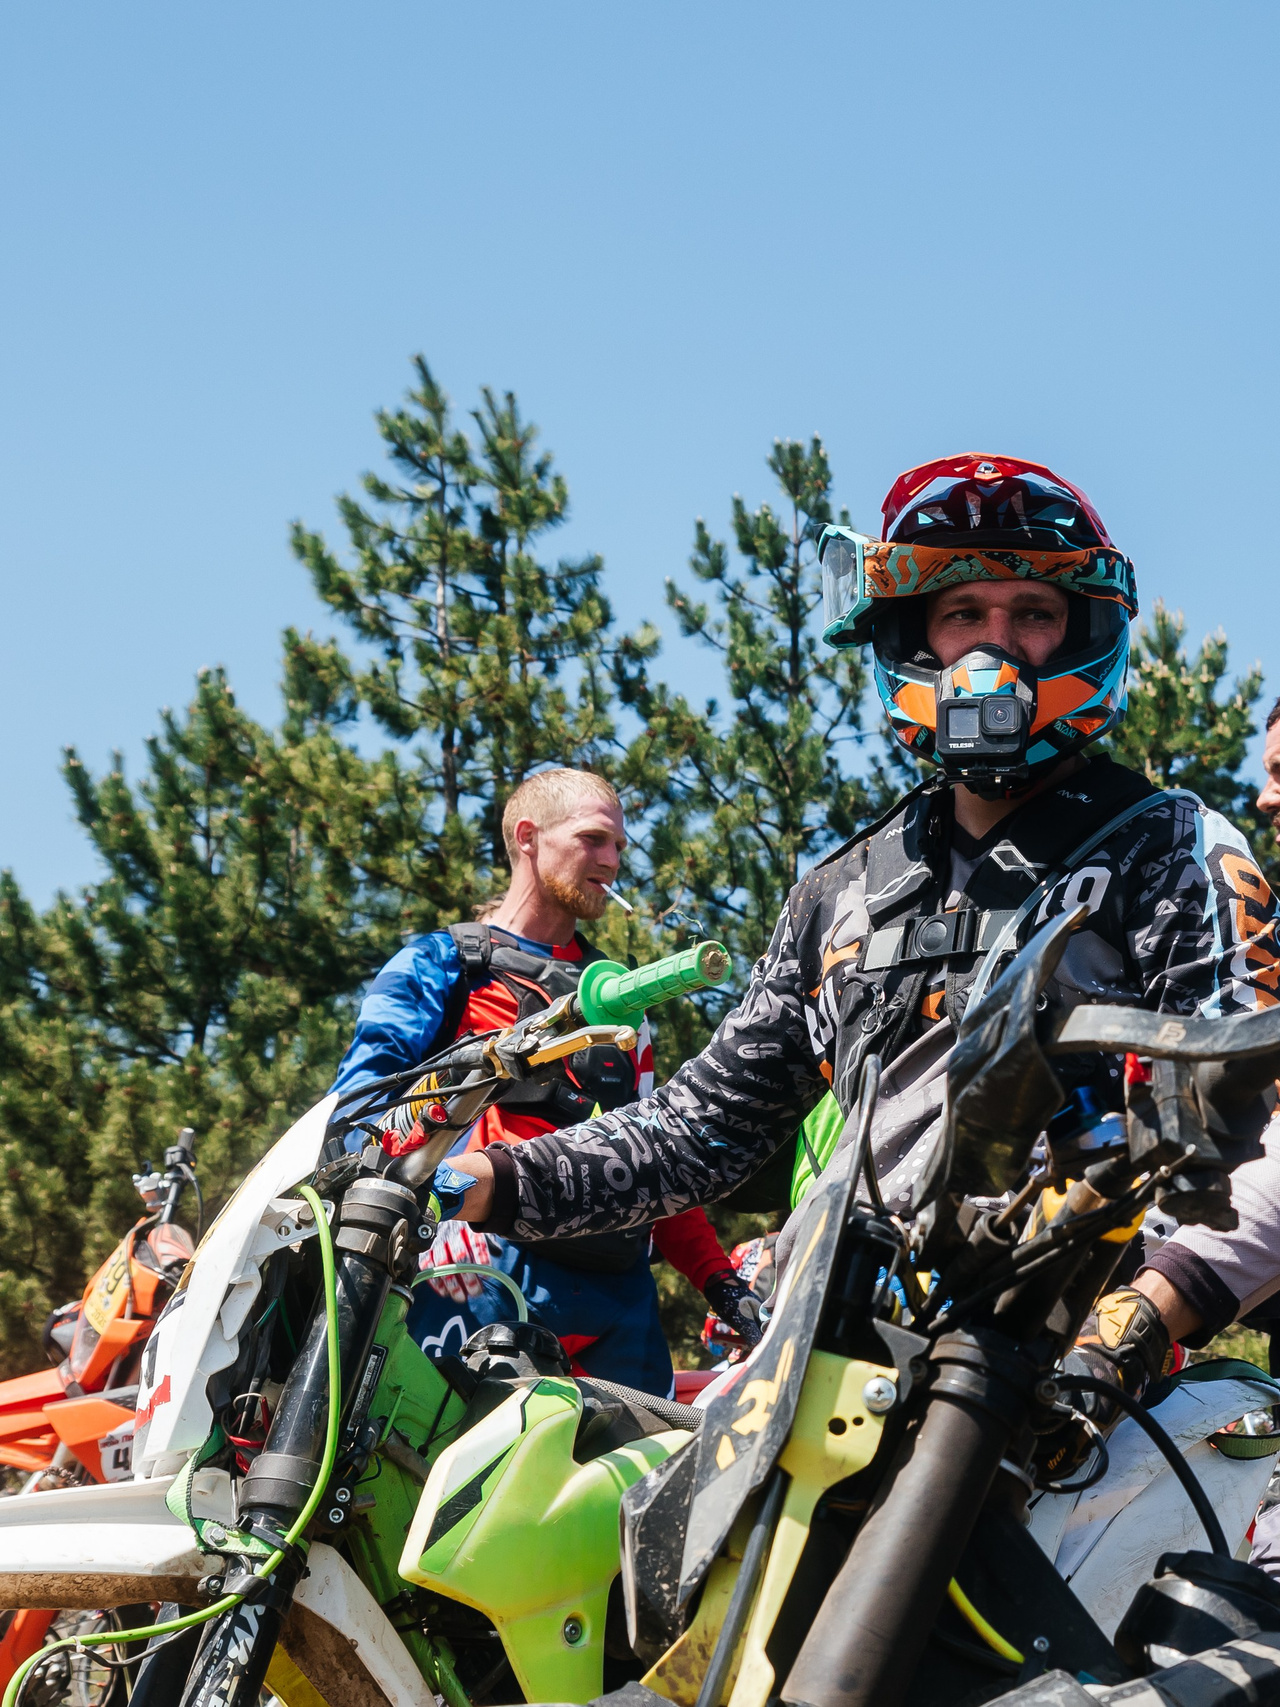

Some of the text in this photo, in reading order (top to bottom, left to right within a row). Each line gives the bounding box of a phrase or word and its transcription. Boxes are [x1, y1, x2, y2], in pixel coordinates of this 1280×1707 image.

[1053, 720, 1078, 739] ATAKI
[743, 1069, 785, 1091] ATAKI
[580, 1163, 591, 1209] ATAKI
